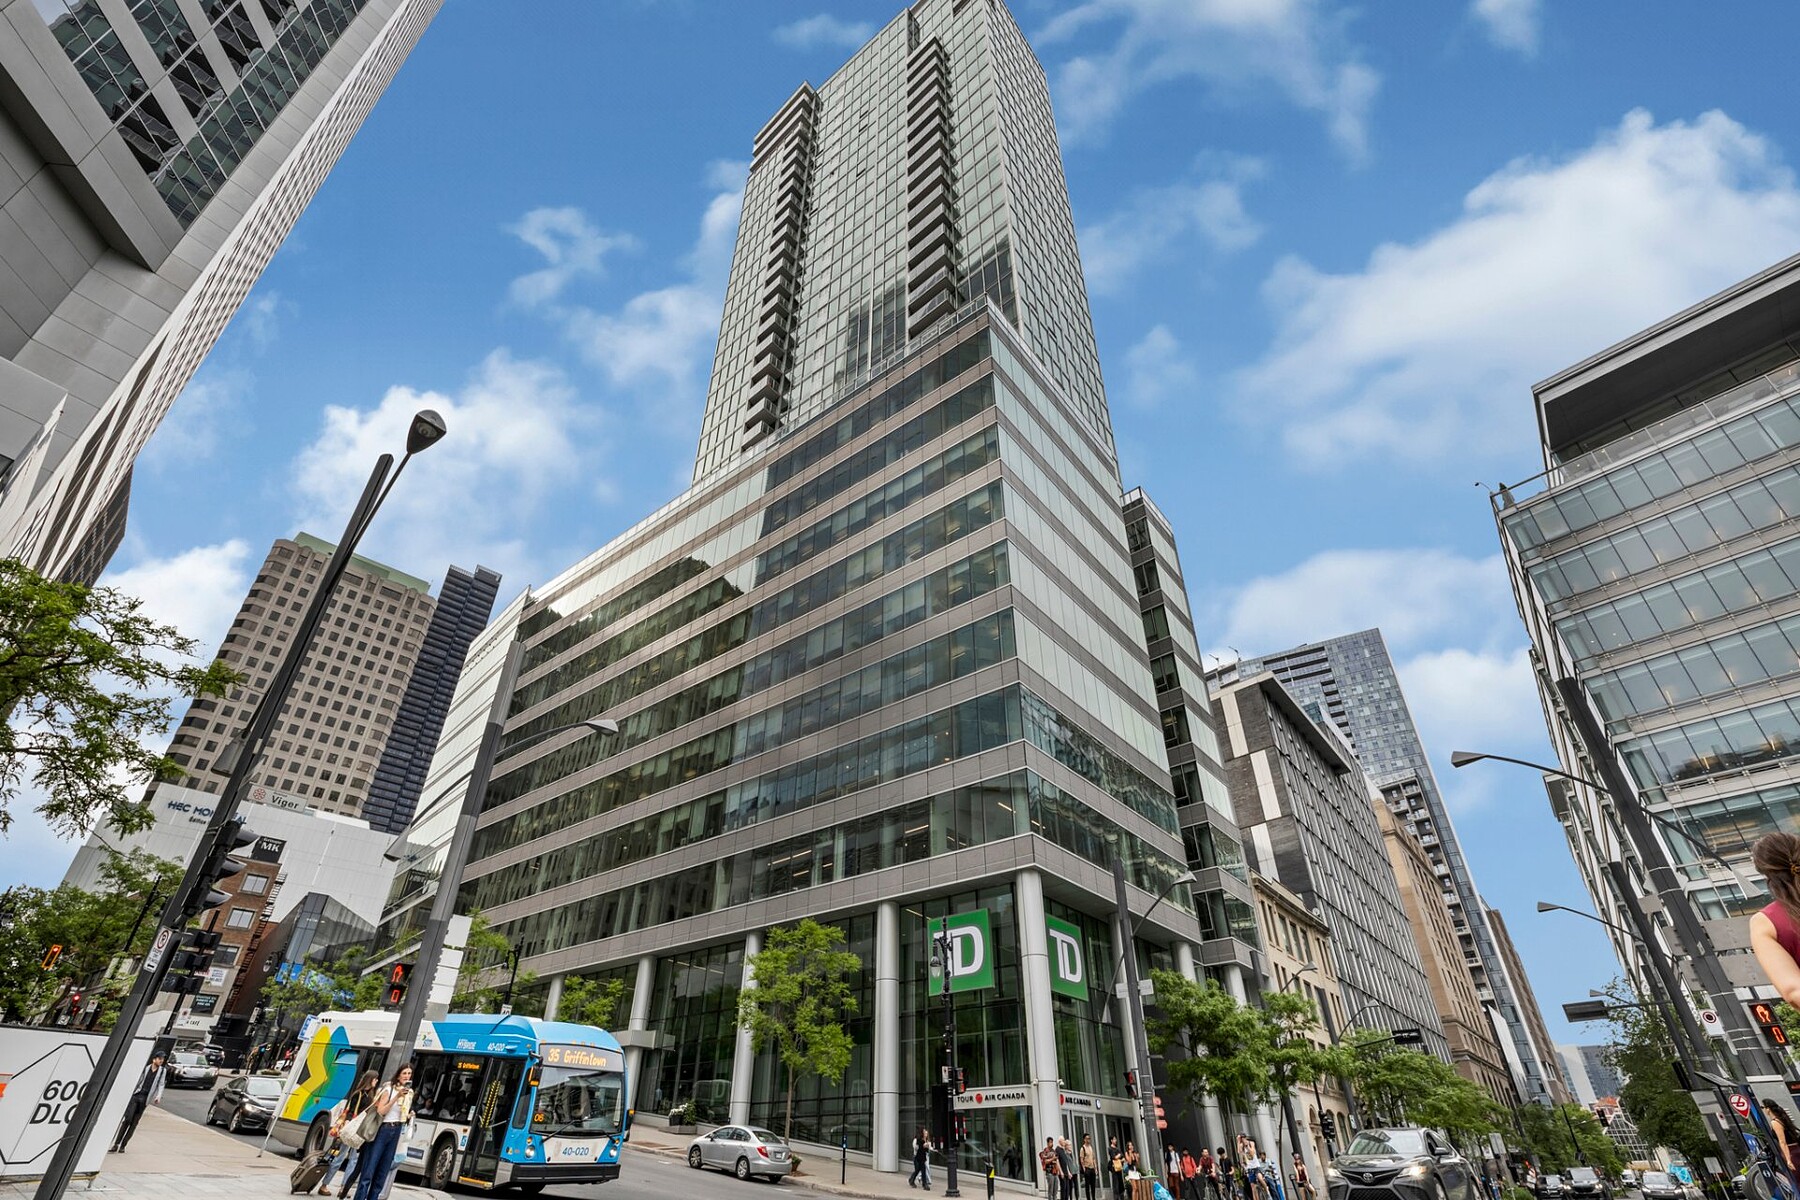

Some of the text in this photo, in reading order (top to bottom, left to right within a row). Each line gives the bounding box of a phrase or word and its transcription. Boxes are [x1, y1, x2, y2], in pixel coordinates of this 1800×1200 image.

[167, 800, 191, 813] HEC
[260, 841, 280, 853] MK
[1049, 928, 1083, 983] TD
[548, 1048, 607, 1067] 35 Griffintown
[956, 1092, 1026, 1103] TOUR AIR CANADA
[562, 1147, 590, 1156] 40-020
